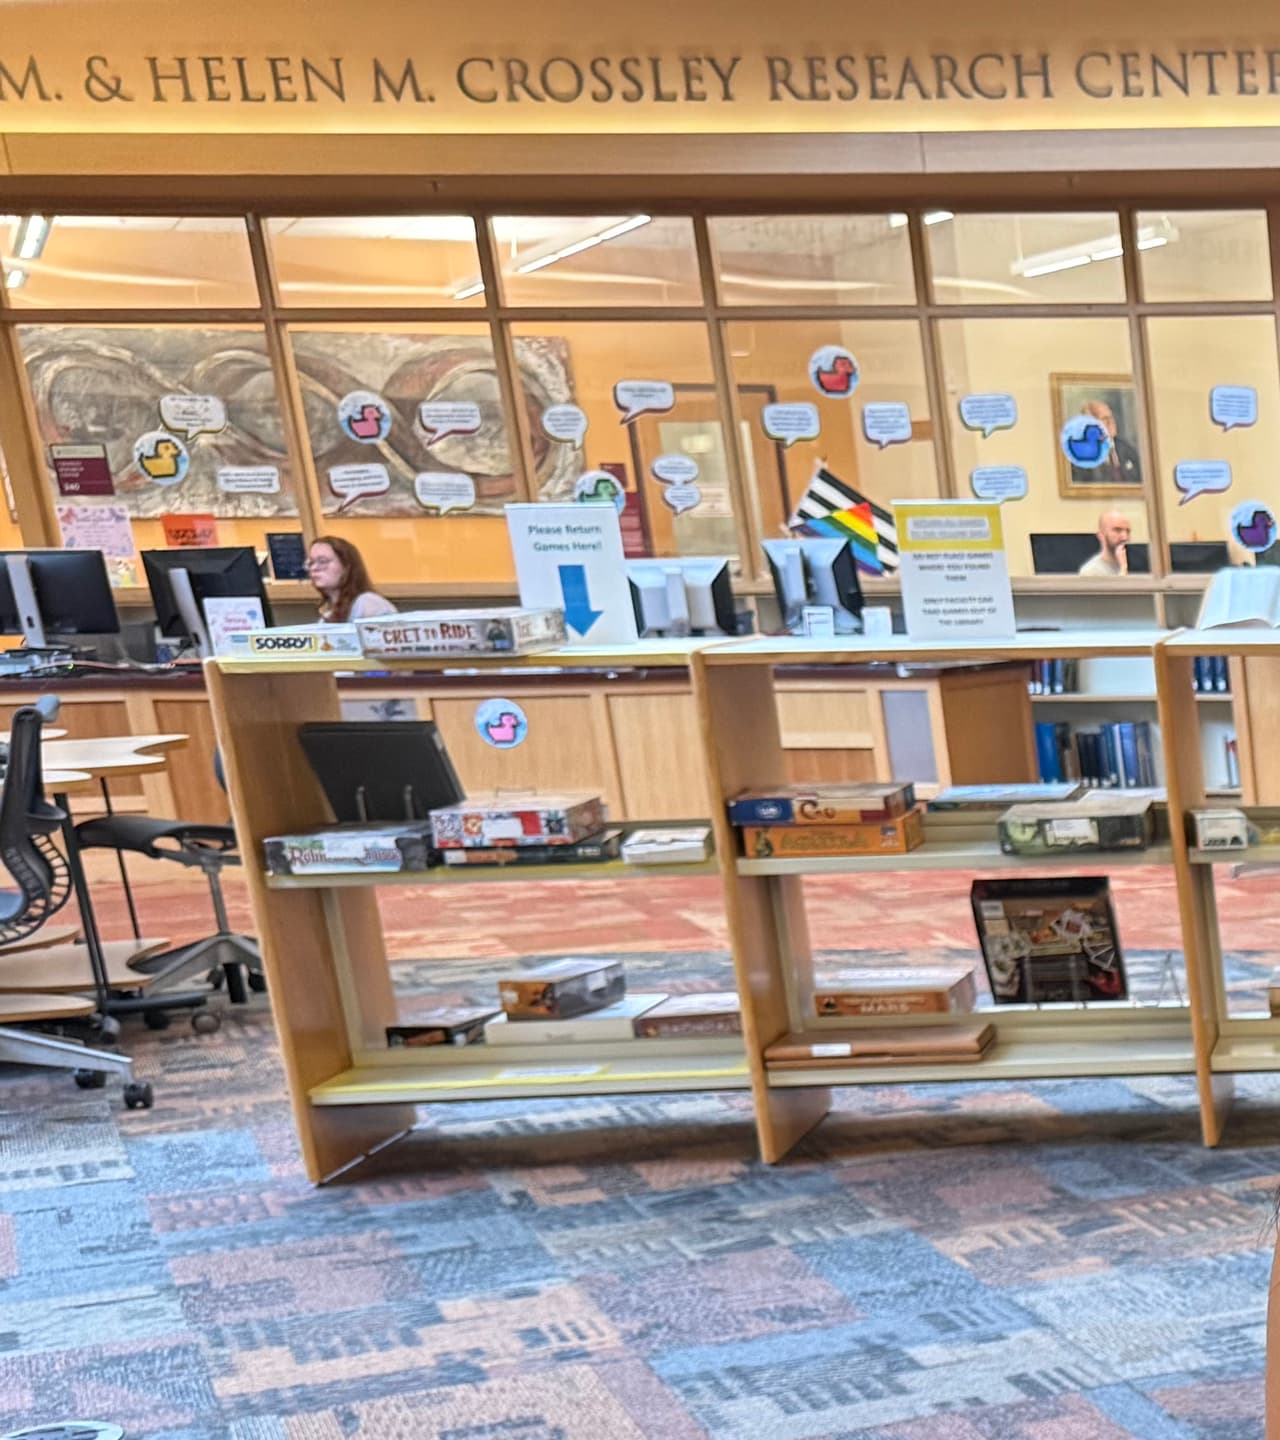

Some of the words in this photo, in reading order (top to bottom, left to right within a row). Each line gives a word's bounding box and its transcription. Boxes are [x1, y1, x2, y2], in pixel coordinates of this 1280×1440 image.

[0, 55, 63, 101] M.
[85, 56, 134, 101] &
[145, 57, 347, 102] HELEN
[372, 57, 436, 102] M.
[456, 56, 741, 104] CROSSLEY
[767, 52, 1054, 102] RESEARCH
[528, 525, 562, 535] Please
[565, 525, 601, 534] Return
[533, 542, 570, 551] Games
[440, 623, 473, 640] RIDE
[255, 636, 313, 650] SORRY!
